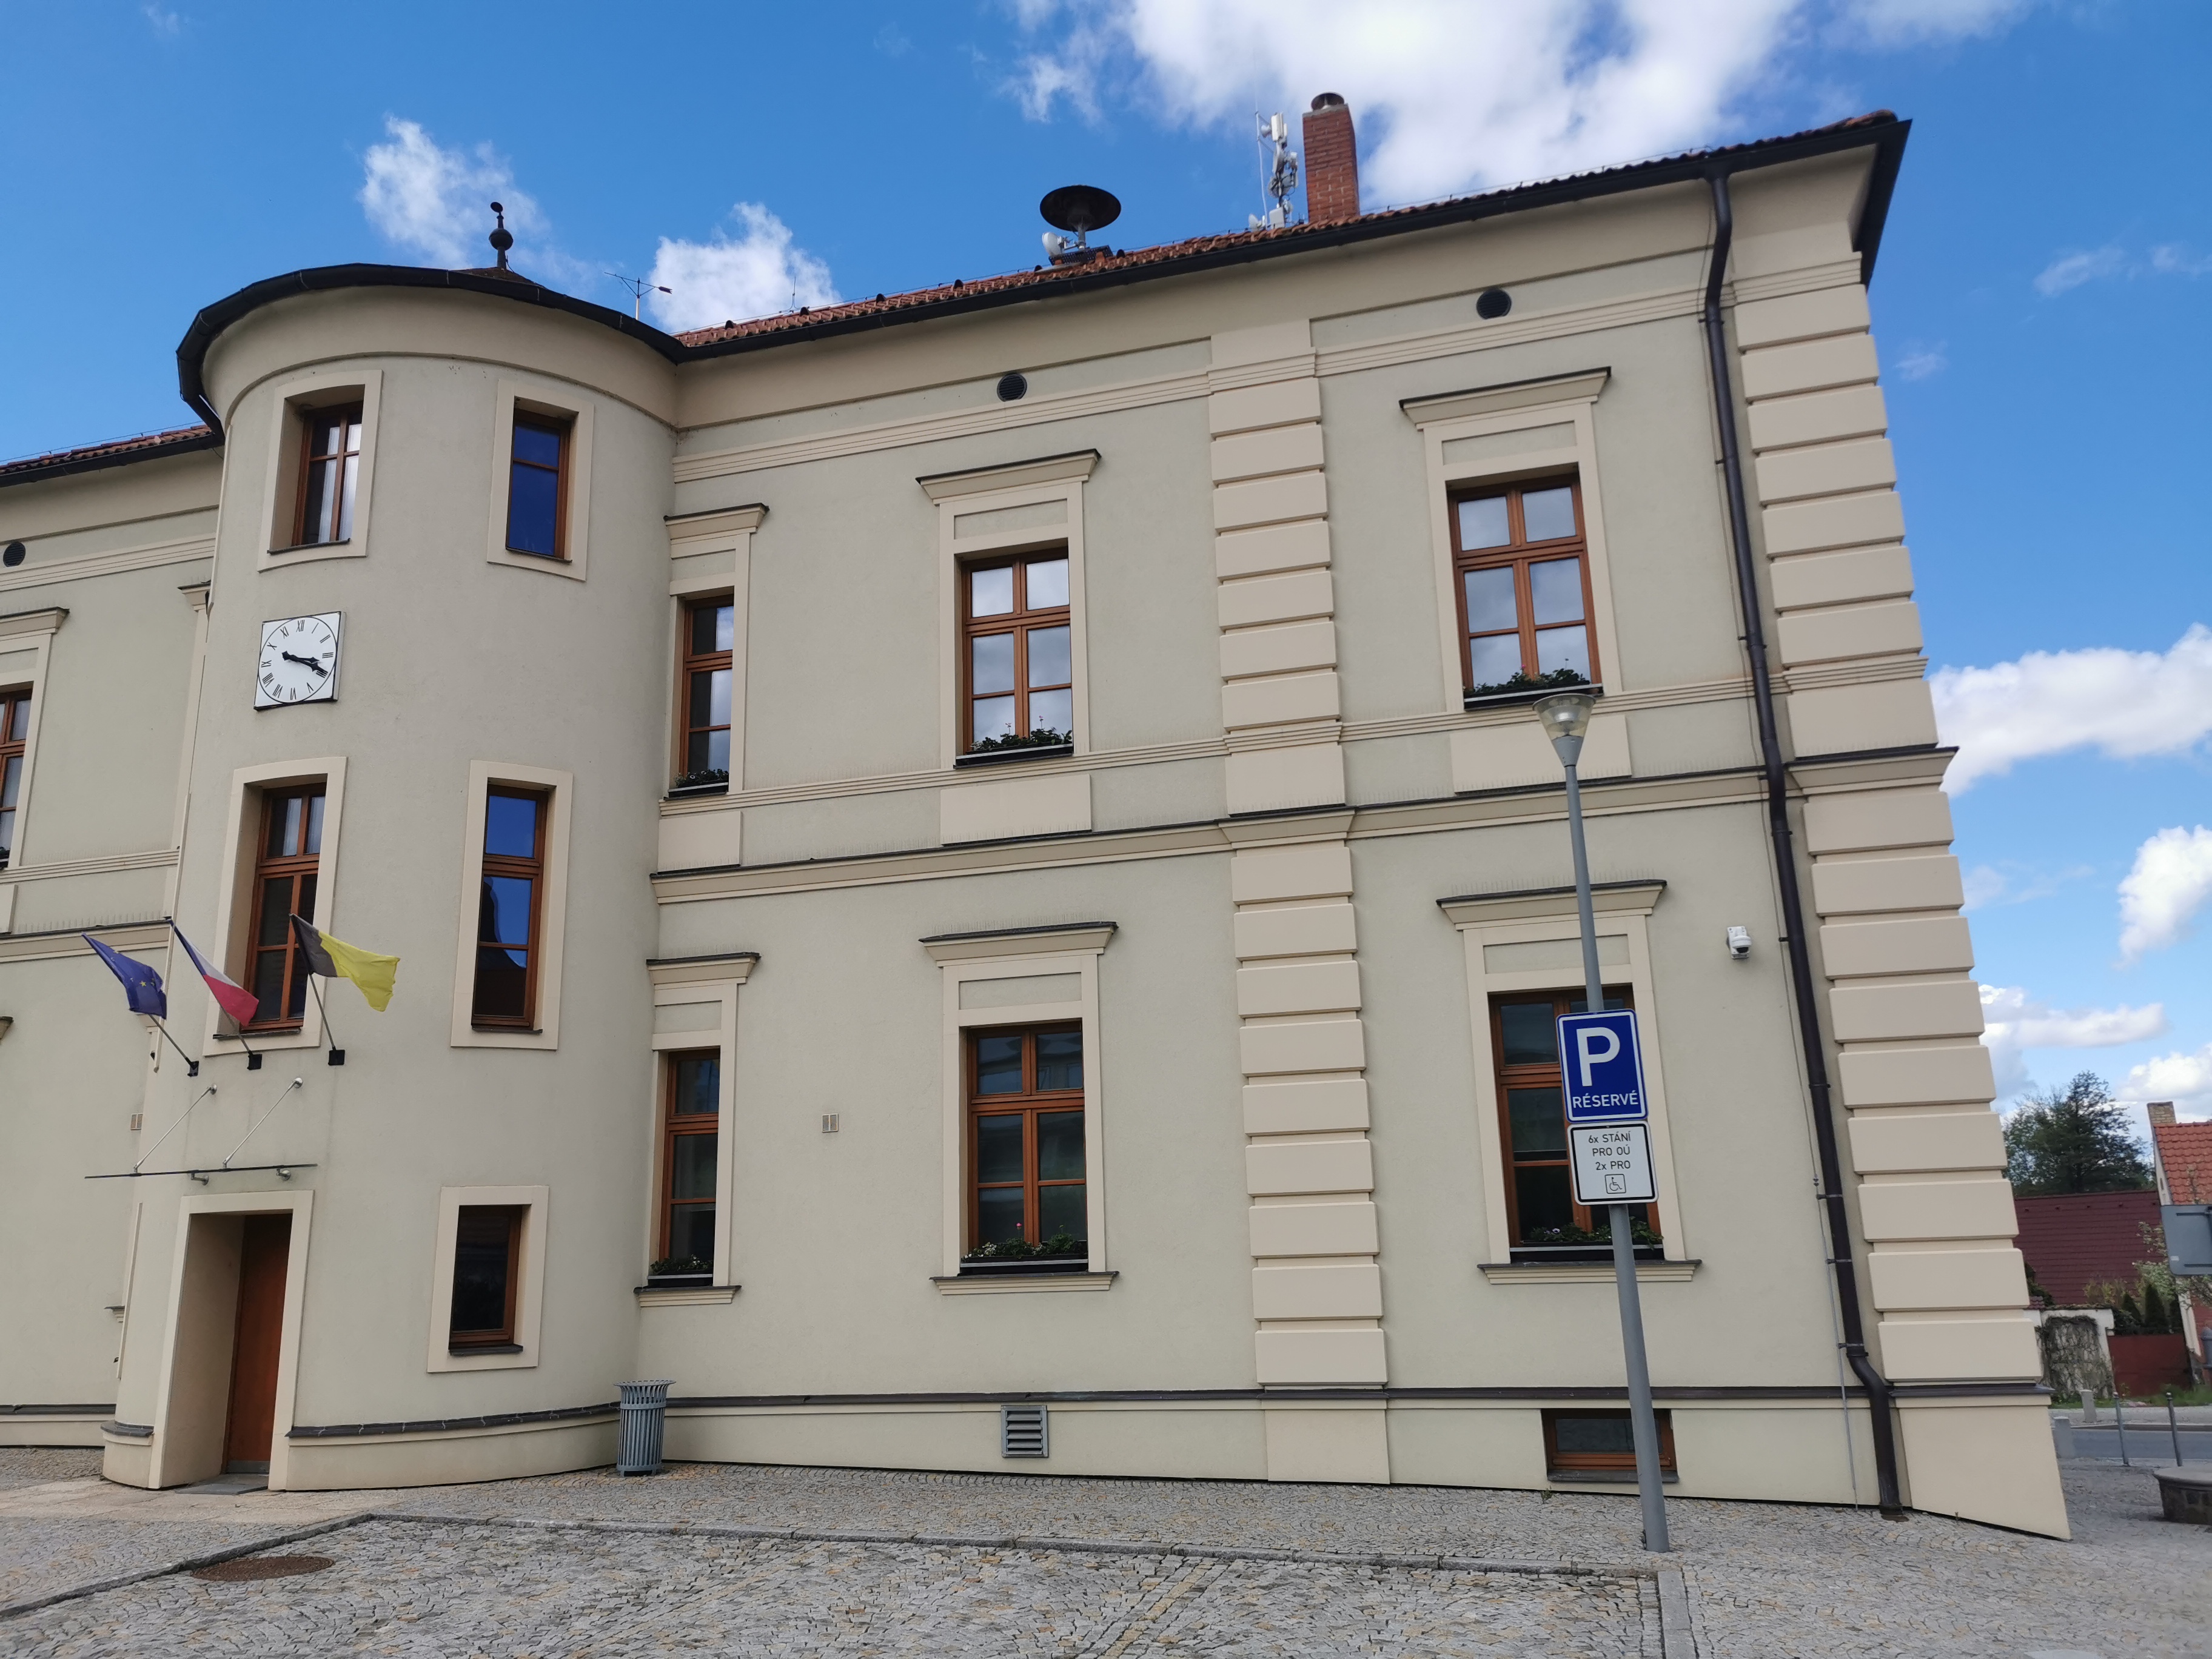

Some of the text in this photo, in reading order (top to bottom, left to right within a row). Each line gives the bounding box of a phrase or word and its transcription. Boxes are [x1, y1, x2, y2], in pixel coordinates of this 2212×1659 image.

[1577, 1027, 1620, 1087] P
[1572, 1090, 1638, 1108] RÉSERVÉ
[1589, 1131, 1631, 1144] 6x STÁNÍ
[1592, 1144, 1630, 1156] PRO OÚ
[1596, 1161, 1631, 1170] 2x PRO
